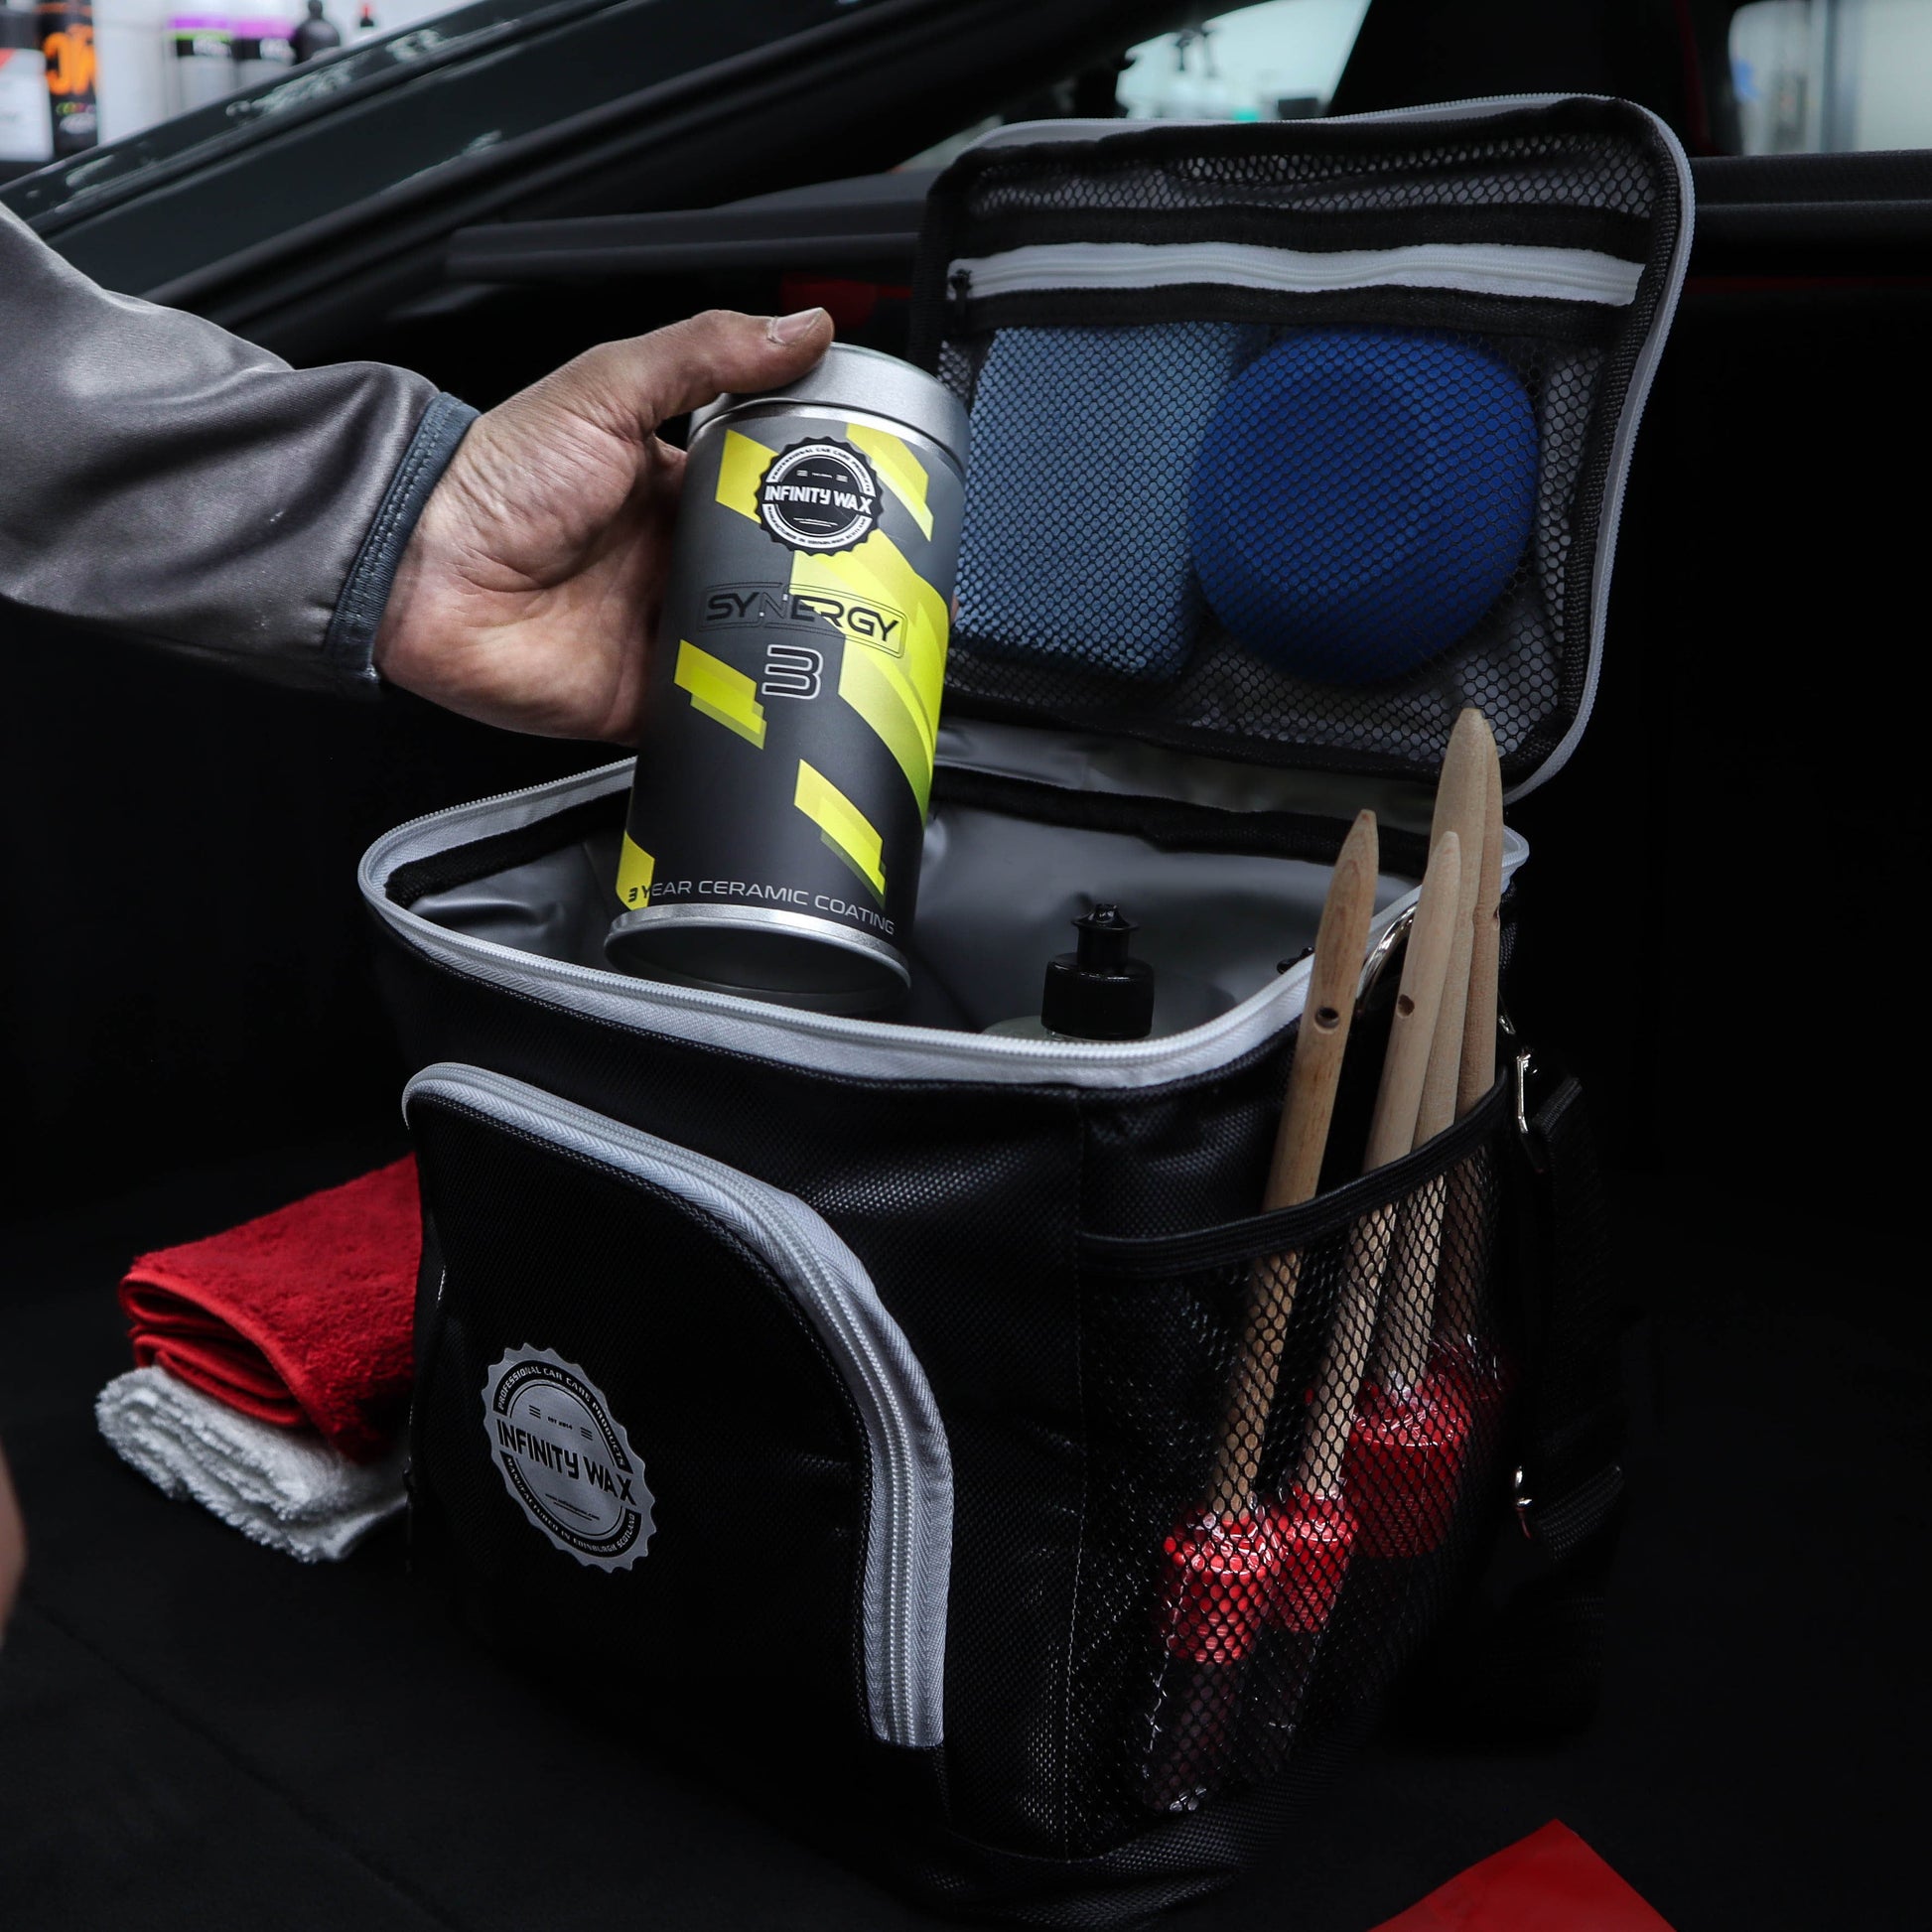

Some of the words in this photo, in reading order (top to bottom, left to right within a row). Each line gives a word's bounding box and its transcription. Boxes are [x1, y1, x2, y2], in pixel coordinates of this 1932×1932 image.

[764, 485, 831, 505] INFINITY
[833, 490, 873, 515] WAX
[706, 592, 899, 642] SYNERGY
[761, 644, 823, 699] 3
[628, 887, 639, 903] 3
[642, 881, 692, 899] YEAR
[698, 881, 809, 906] CERAMIC
[814, 895, 895, 936] COATING
[497, 1365, 542, 1411] PROFESSIONAL
[543, 1367, 563, 1381] CAR
[565, 1376, 591, 1402] CARE
[592, 1401, 625, 1467] PRODUCTS
[496, 1418, 580, 1480] INFINITY
[583, 1455, 637, 1507] WAX
[506, 1456, 559, 1532] MANUFACTURED
[561, 1526, 571, 1541] IN
[573, 1537, 618, 1553] EDINBURGH
[616, 1512, 635, 1549] SCOTLAND
